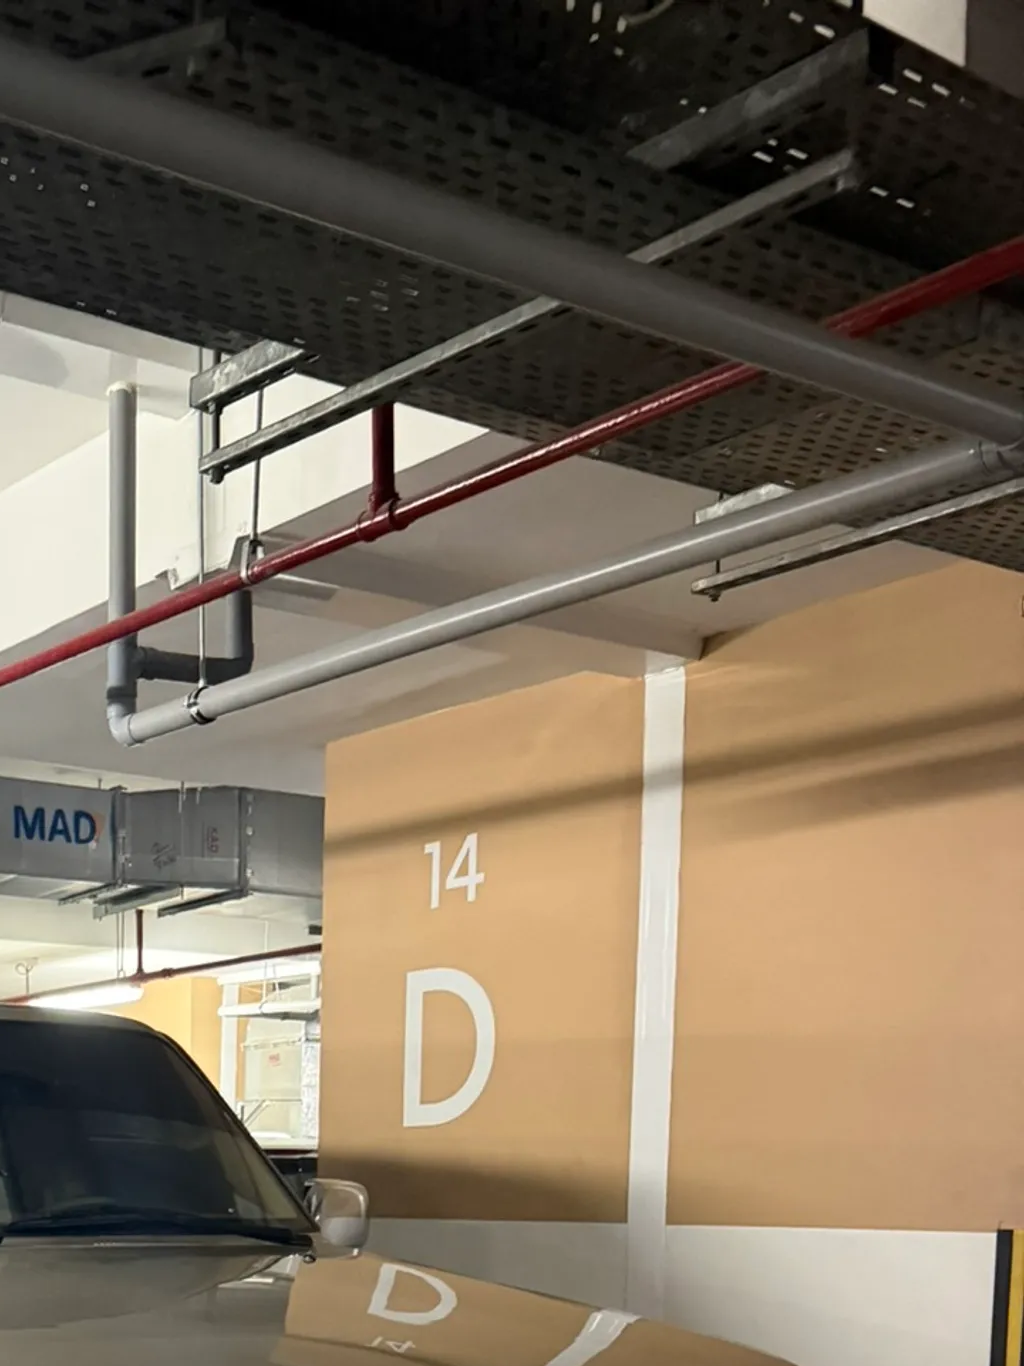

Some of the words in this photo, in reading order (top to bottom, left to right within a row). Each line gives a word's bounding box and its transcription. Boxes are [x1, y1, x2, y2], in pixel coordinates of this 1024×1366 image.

[13, 805, 97, 845] MAD
[424, 832, 485, 910] 14
[403, 967, 496, 1128] D
